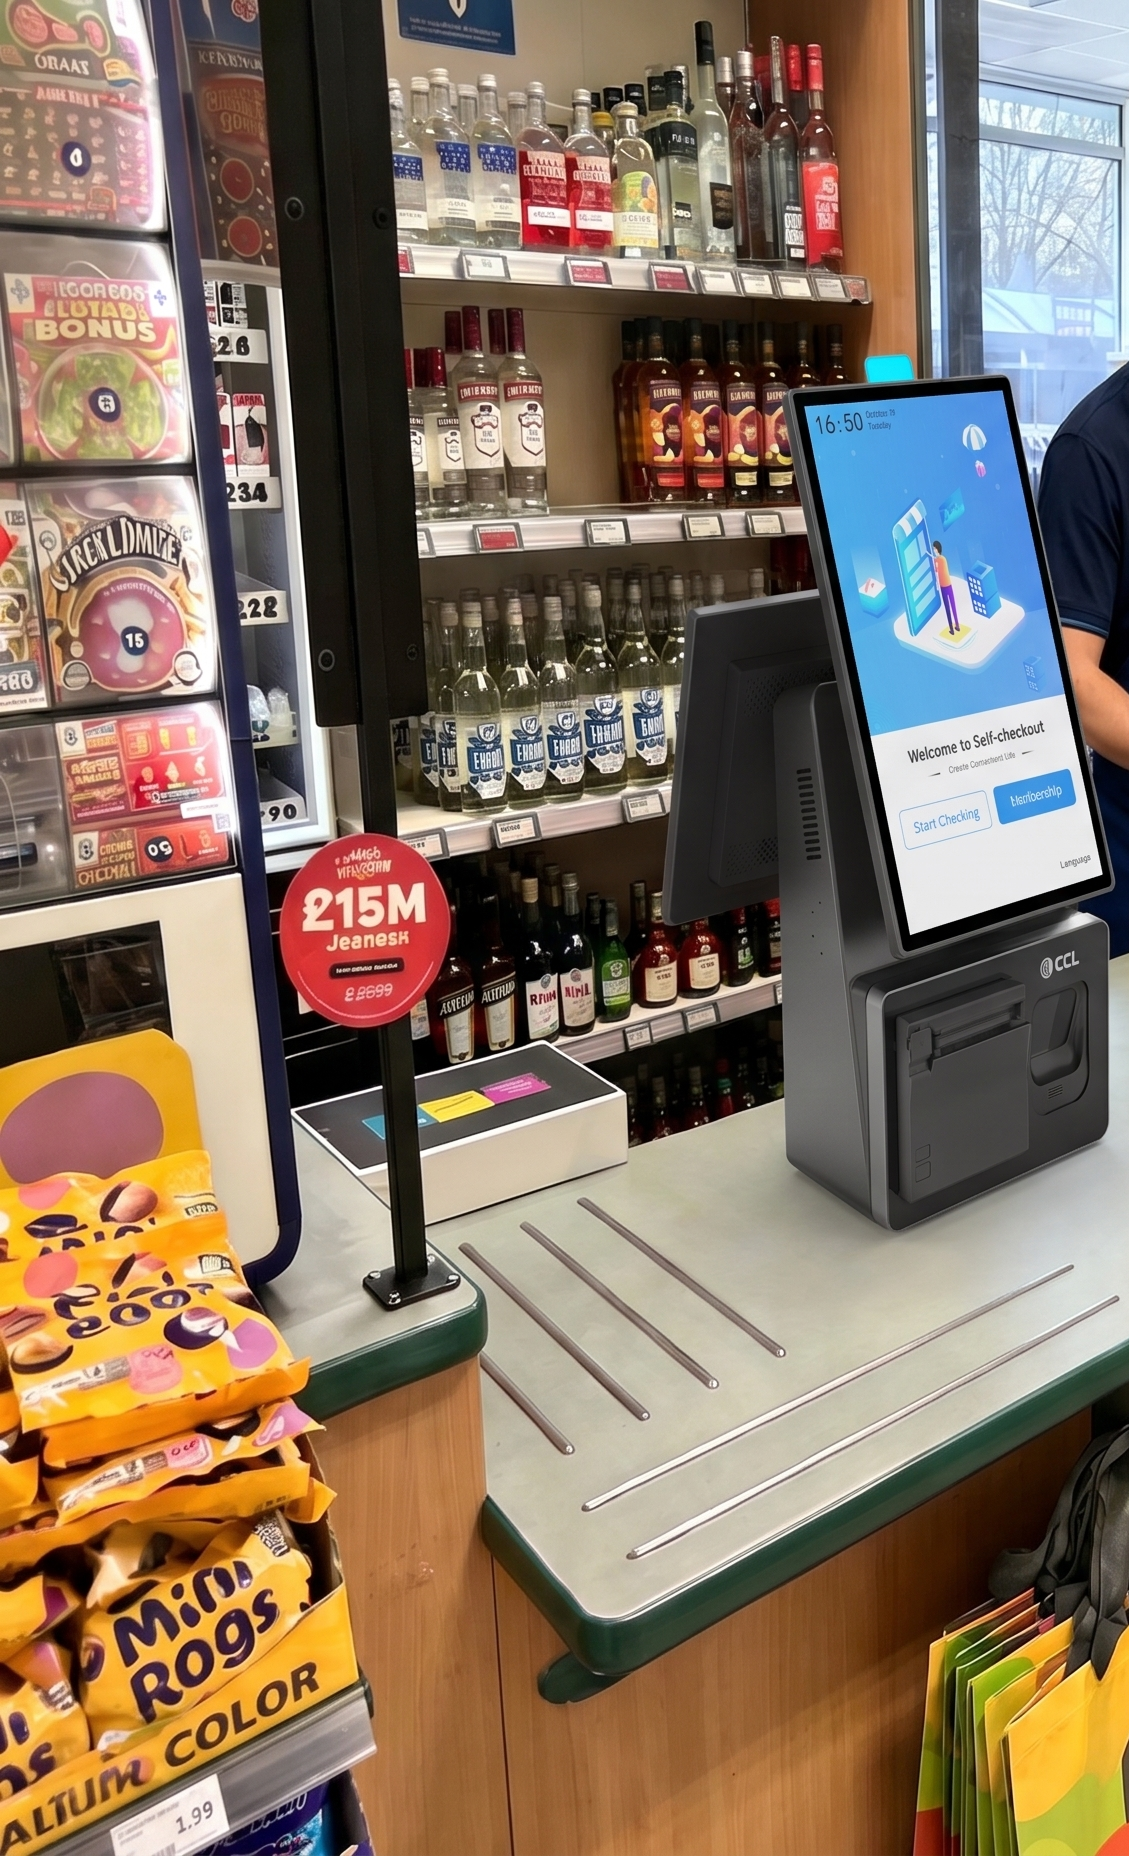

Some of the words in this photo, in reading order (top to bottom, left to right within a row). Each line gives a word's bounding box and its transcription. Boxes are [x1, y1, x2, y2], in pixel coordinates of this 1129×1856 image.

[35, 318, 157, 343] BONUS
[815, 412, 863, 434] 16:50
[125, 632, 145, 649] 15
[907, 739, 958, 763] Welcome
[959, 739, 972, 752] to
[972, 720, 1045, 748] Self-checkout
[913, 818, 937, 834] Start
[938, 807, 980, 828] Checking
[302, 882, 426, 932] £15M
[1054, 950, 1080, 972] CCL
[130, 1588, 279, 1724] Rogs
[164, 1661, 320, 1767] COLOR
[176, 1801, 214, 1835] 1.99
